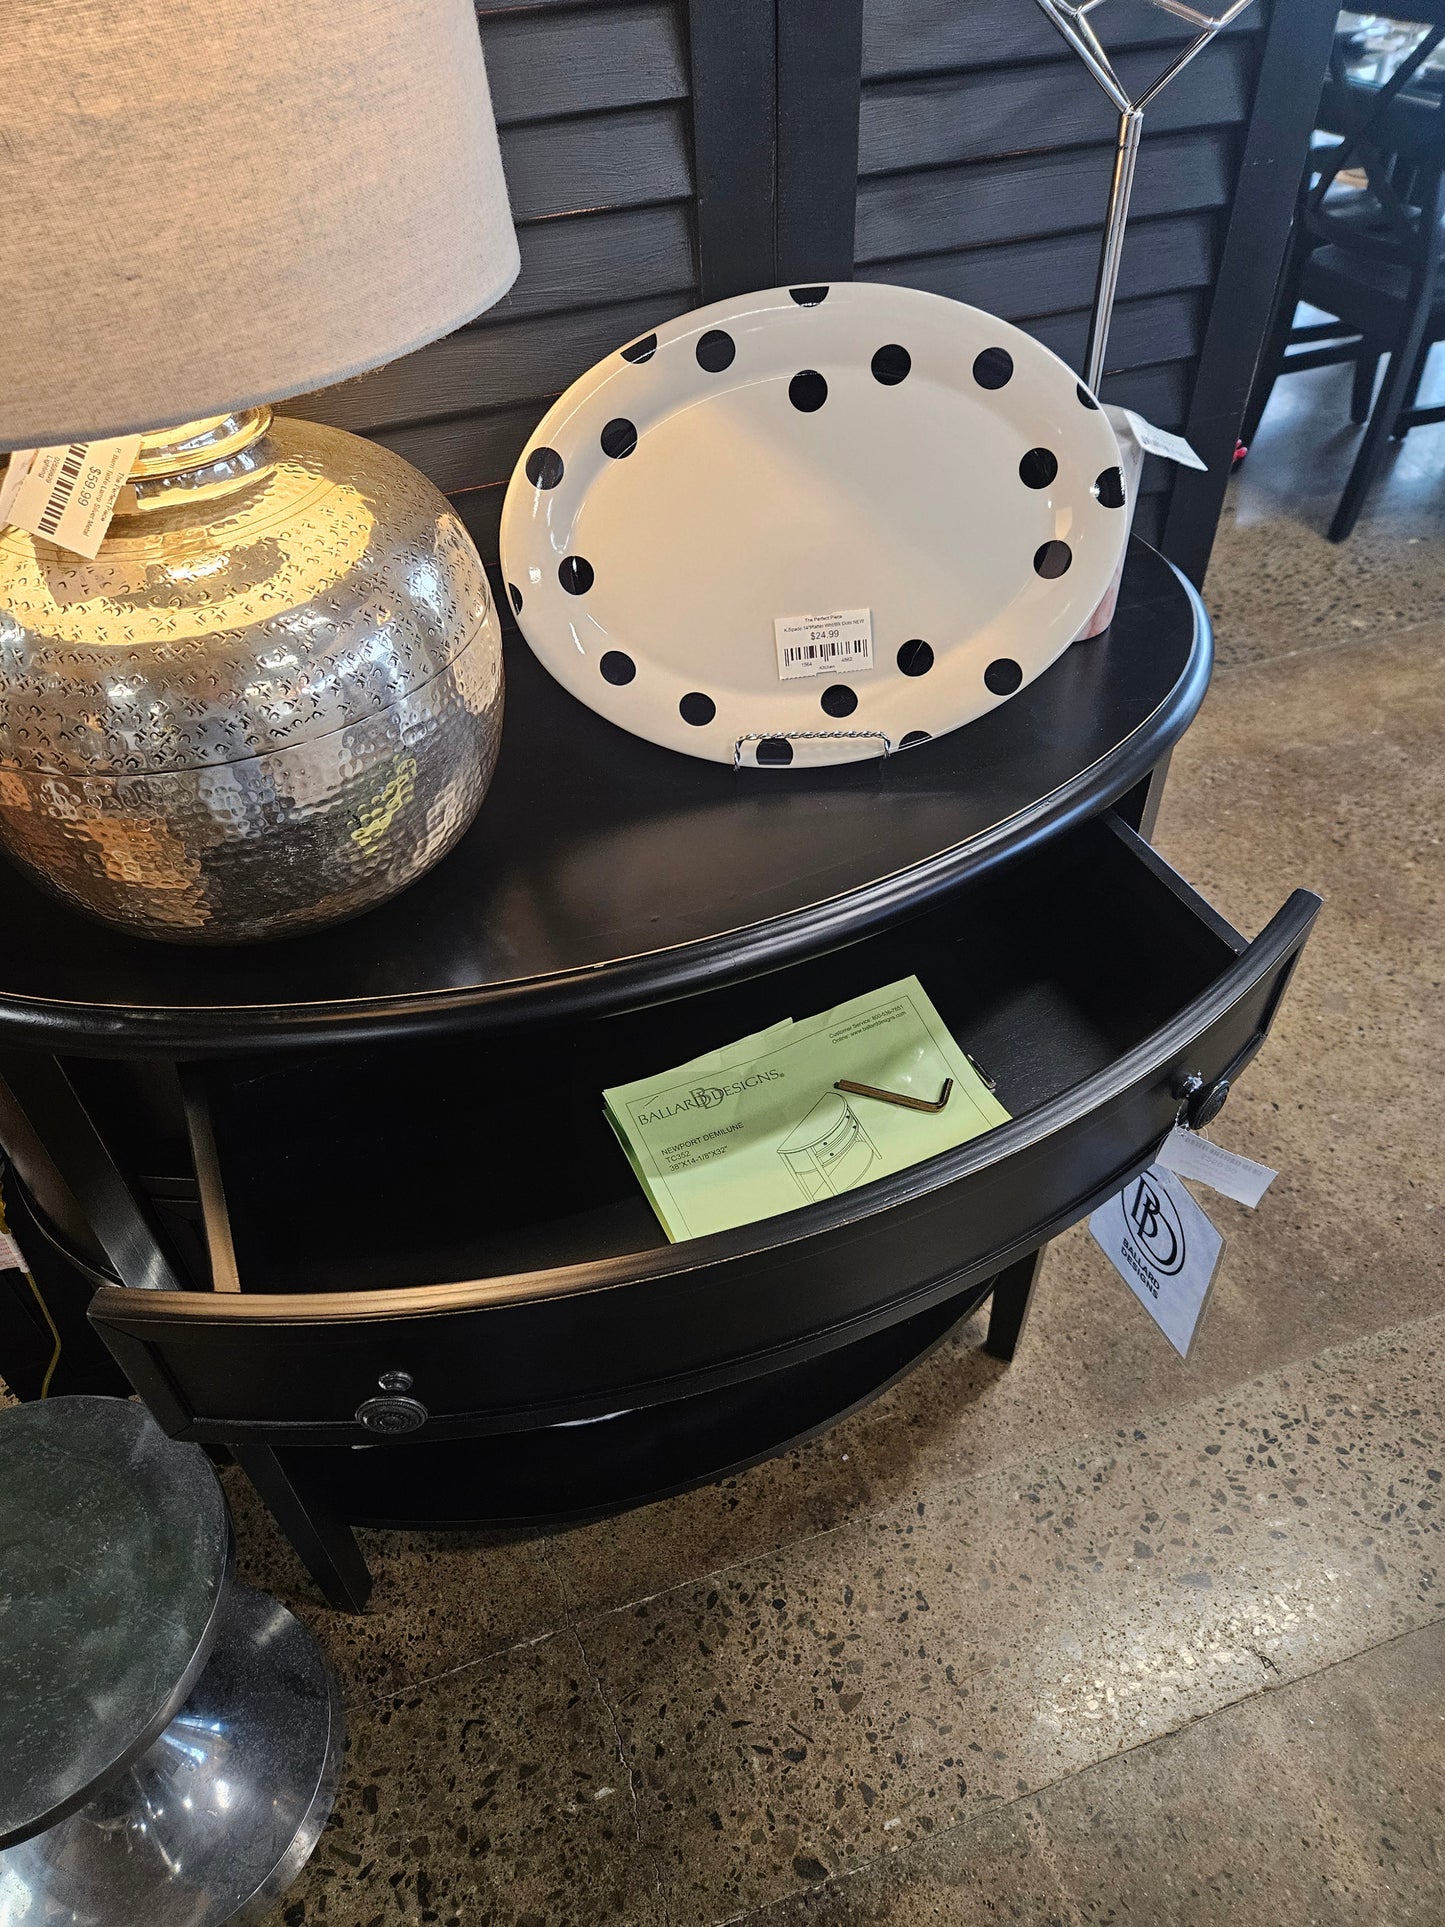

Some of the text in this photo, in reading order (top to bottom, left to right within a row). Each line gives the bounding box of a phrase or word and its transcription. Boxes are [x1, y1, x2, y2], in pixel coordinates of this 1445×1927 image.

[38, 455, 54, 479] Lighting
[110, 454, 120, 469] Barn
[77, 466, 102, 507] $59.99
[104, 469, 115, 487] Table
[95, 486, 107, 503] Lamp
[100, 472, 125, 522] The Perfect Piece
[88, 503, 101, 521] Silver
[83, 520, 94, 537] Metal
[810, 629, 840, 641] $24.99
[829, 1026, 852, 1039] Customer
[637, 1091, 711, 1126] BALLARD
[661, 1121, 745, 1156] NEWPORT DEMILUNE
[665, 1151, 691, 1164] TC352
[1121, 1246, 1158, 1299] DESIGNS
[1122, 1238, 1160, 1290] BALLARD
